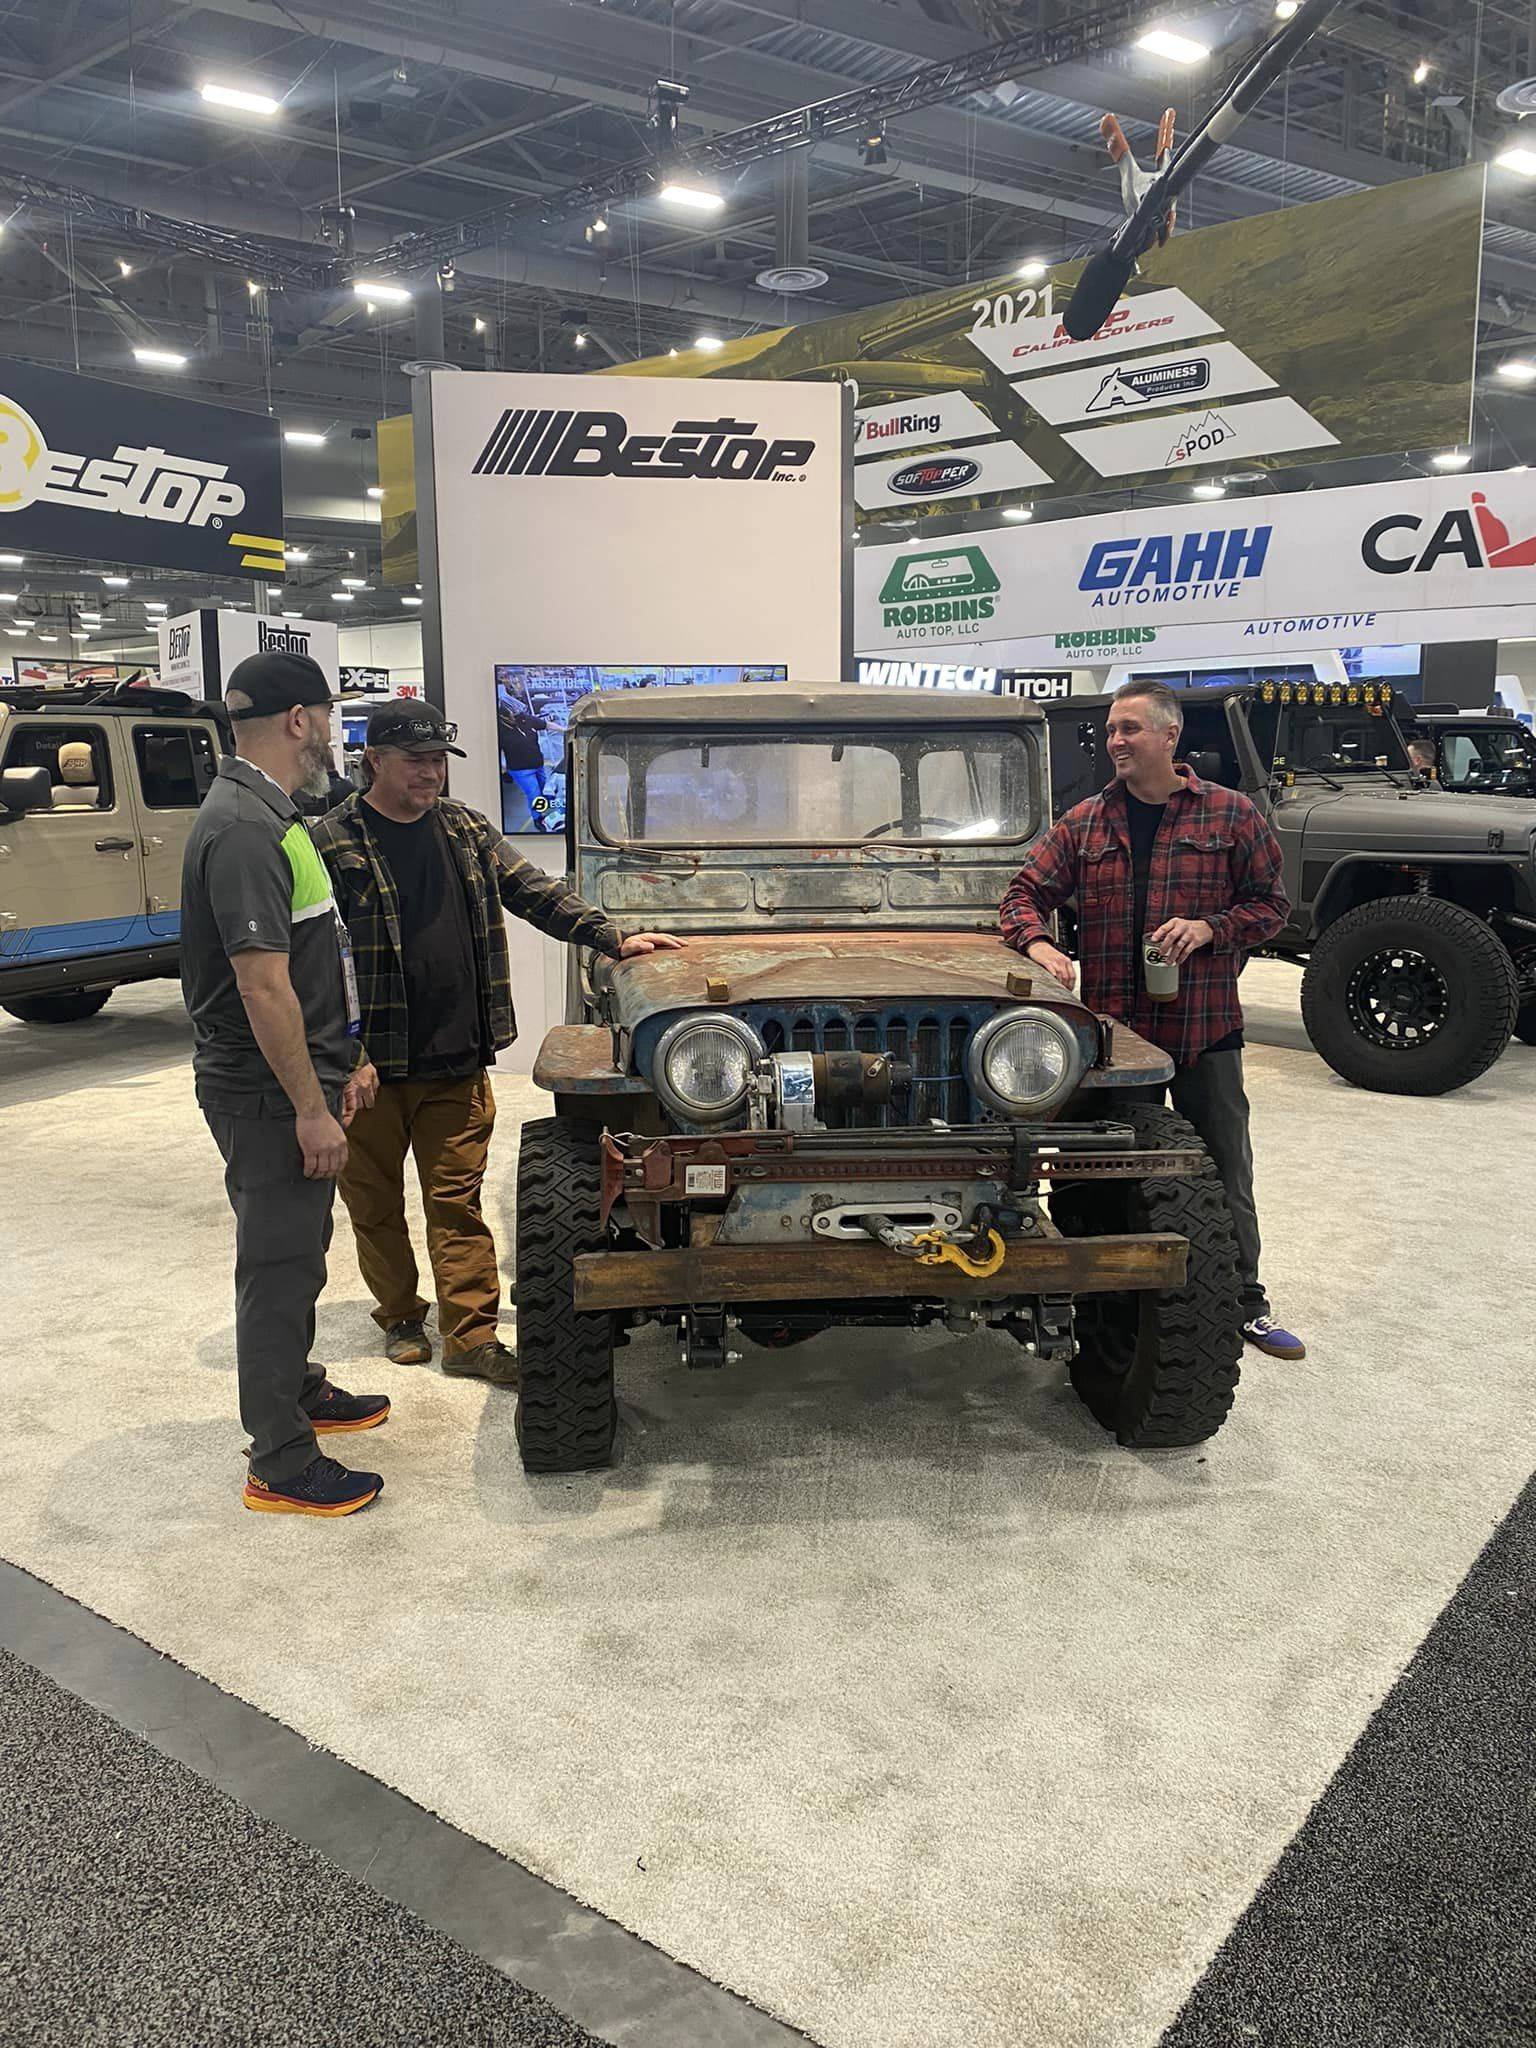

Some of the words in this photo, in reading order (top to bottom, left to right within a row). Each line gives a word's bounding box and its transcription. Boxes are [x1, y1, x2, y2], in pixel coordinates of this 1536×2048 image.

[972, 284, 1053, 333] 2021
[1012, 336, 1094, 357] CALIP
[1093, 315, 1175, 341] COVERS
[1131, 365, 1198, 386] ALUMINESS
[1146, 383, 1181, 394] Products
[866, 414, 941, 440] BullRing
[545, 410, 816, 480] BESTOP
[1176, 429, 1225, 461] sPOD
[771, 471, 796, 482] Inc.
[1078, 525, 1273, 591] GAHH
[1092, 582, 1241, 607] AUTOMOTIVE
[883, 597, 995, 628] ROBBINS
[1244, 613, 1377, 636] AUTOMOTIVE
[897, 628, 927, 640] AUTO
[931, 625, 954, 637] TOP,
[958, 623, 980, 634] LLC
[1055, 626, 1157, 649] ROBBINS
[1066, 648, 1093, 659] AUTO
[1096, 647, 1119, 659] TOP,
[1122, 646, 1142, 656] LLC
[344, 668, 388, 689] XPEL
[859, 662, 997, 691] WINTECH
[396, 686, 417, 698] 3M
